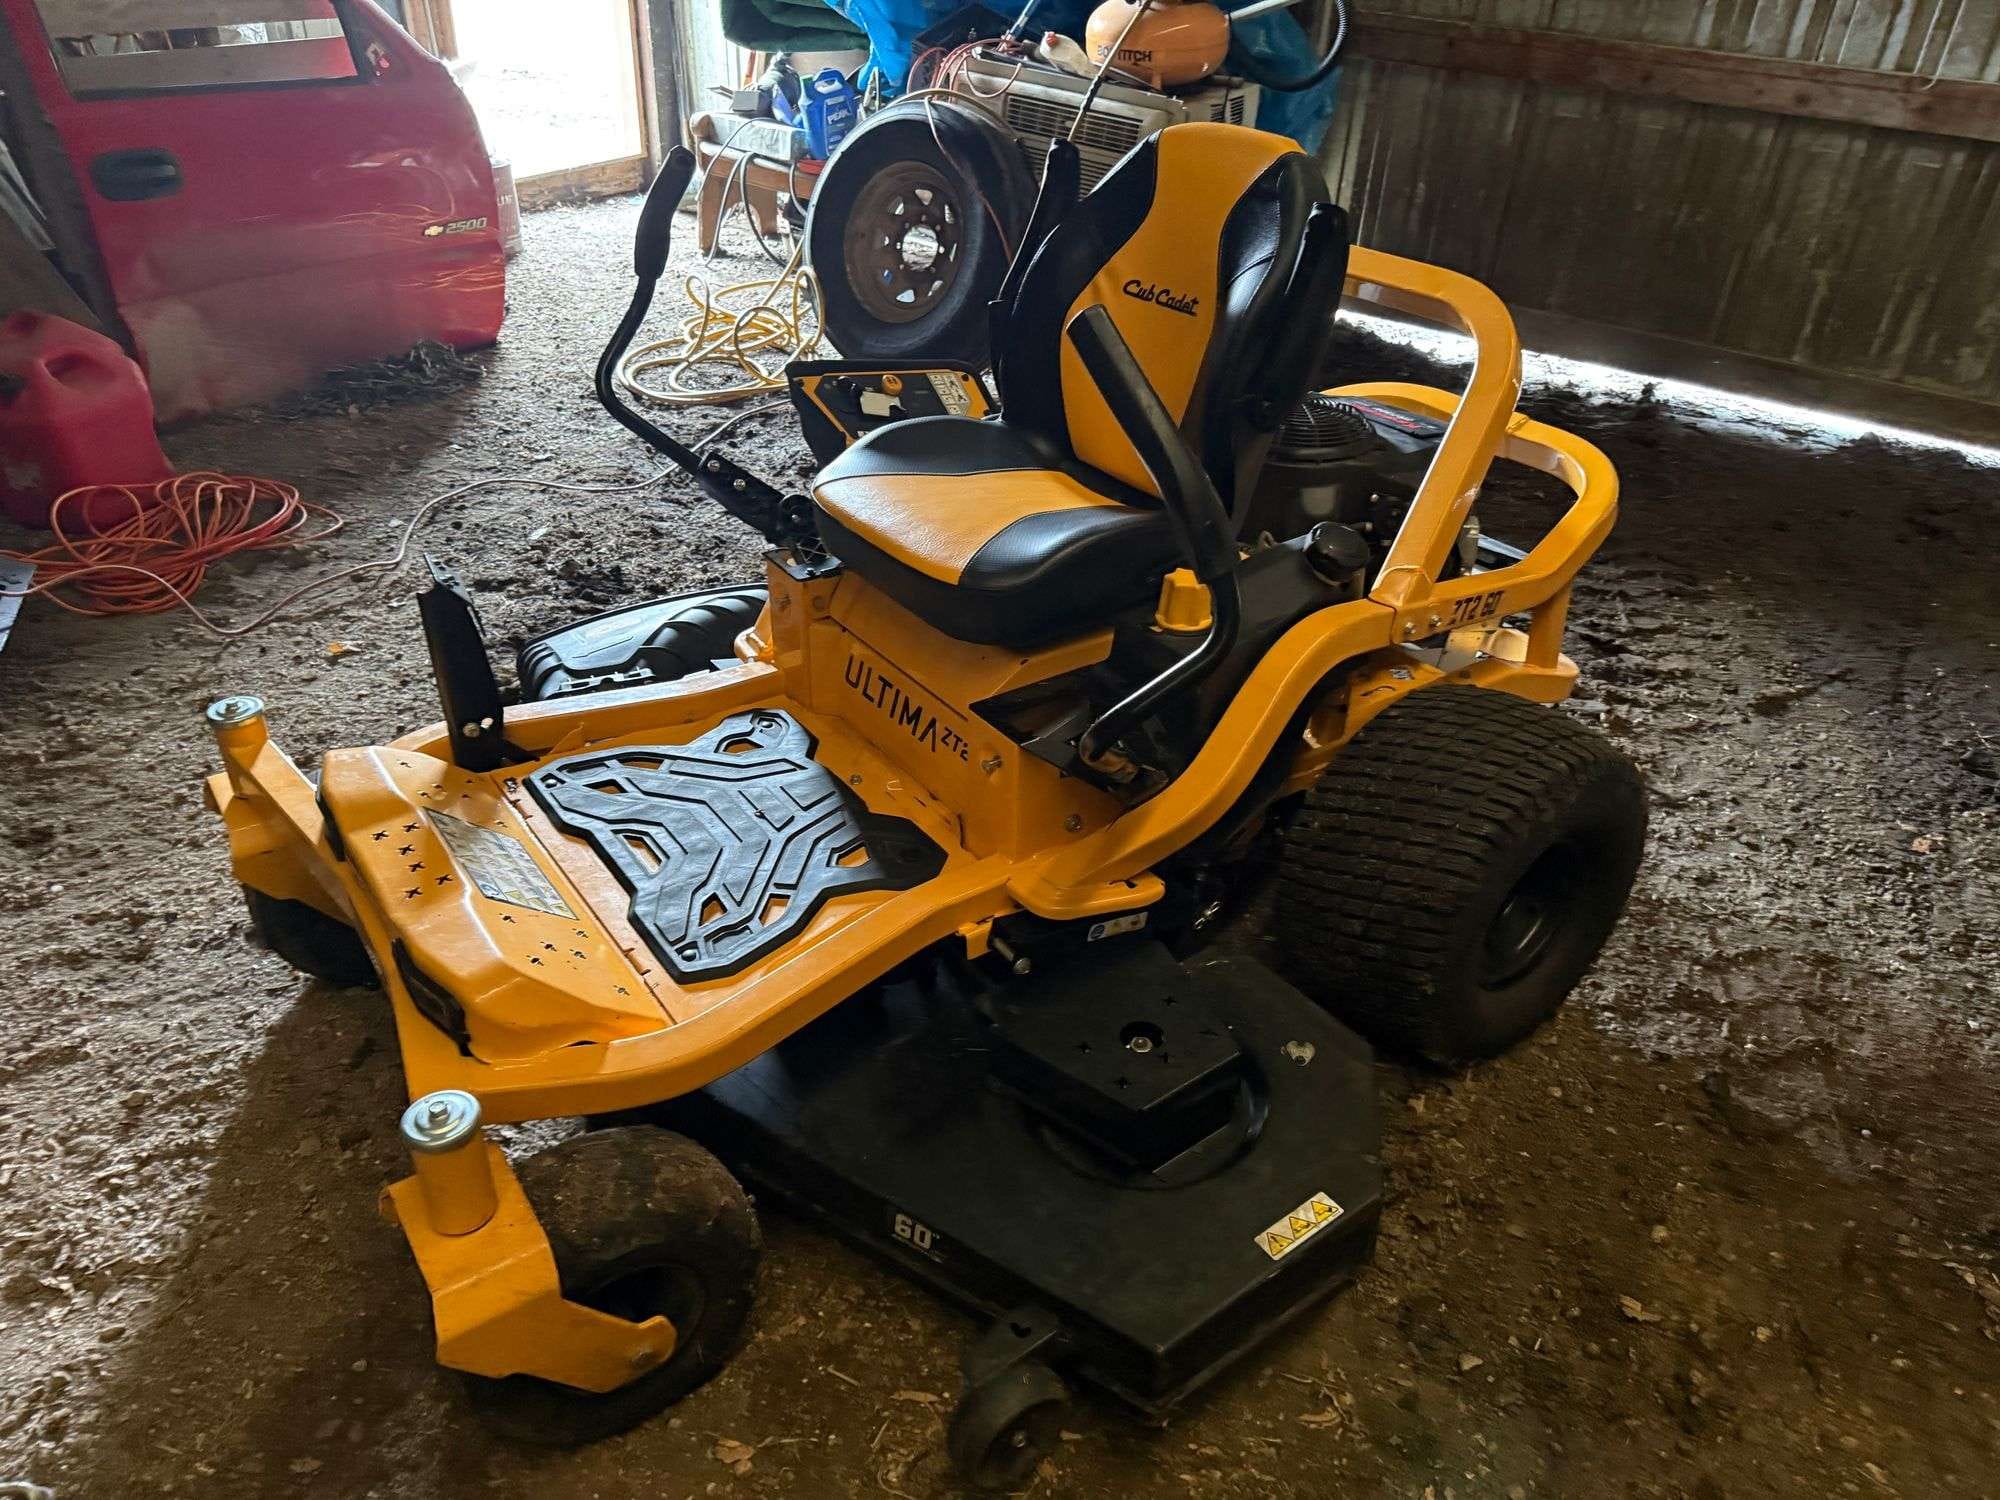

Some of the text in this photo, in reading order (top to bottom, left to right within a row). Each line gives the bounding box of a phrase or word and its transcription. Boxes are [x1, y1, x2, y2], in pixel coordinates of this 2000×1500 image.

[1097, 45, 1153, 62] BOTITCH
[446, 217, 487, 234] 2500
[1123, 280, 1199, 317] Cub Cadet
[845, 655, 937, 753] ULTIMA
